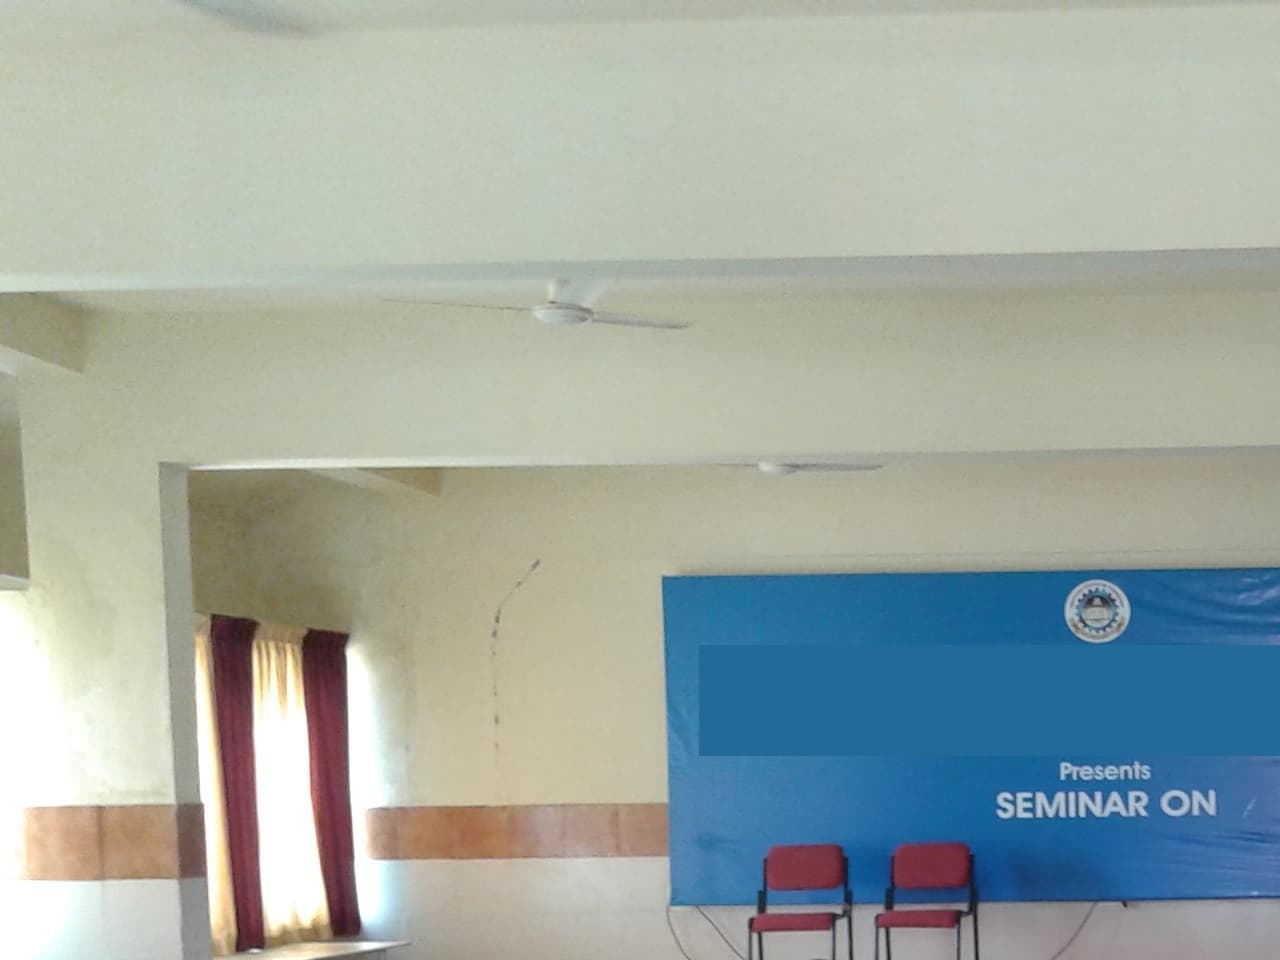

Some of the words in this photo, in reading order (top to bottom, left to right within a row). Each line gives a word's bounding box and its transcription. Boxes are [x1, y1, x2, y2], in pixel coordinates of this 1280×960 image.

[1059, 761, 1151, 780] Presents
[996, 790, 1149, 819] SEMINAR
[1159, 789, 1217, 817] ON
